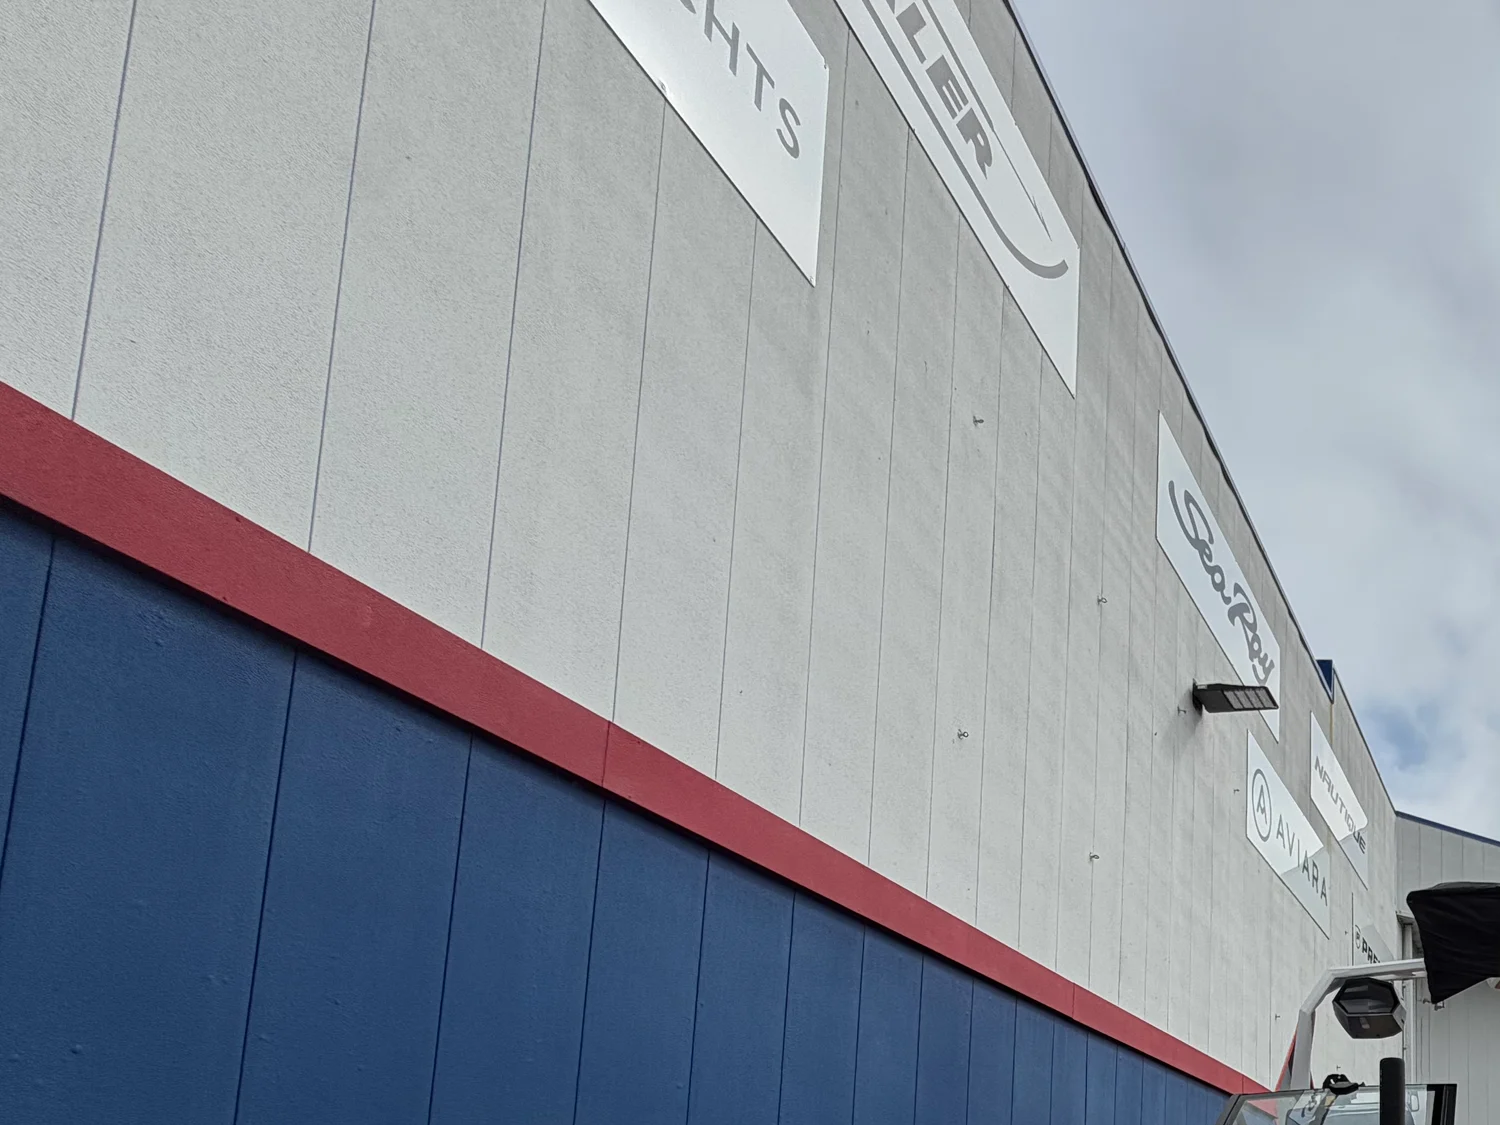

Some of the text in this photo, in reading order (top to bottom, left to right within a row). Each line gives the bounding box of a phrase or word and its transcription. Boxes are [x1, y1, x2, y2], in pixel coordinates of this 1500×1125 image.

[679, 0, 801, 159] HTS
[884, 0, 993, 180] LER
[1168, 480, 1275, 687] Sea Ray
[1276, 813, 1328, 907] AVIARA
[1314, 755, 1366, 855] NAUTIQUE
